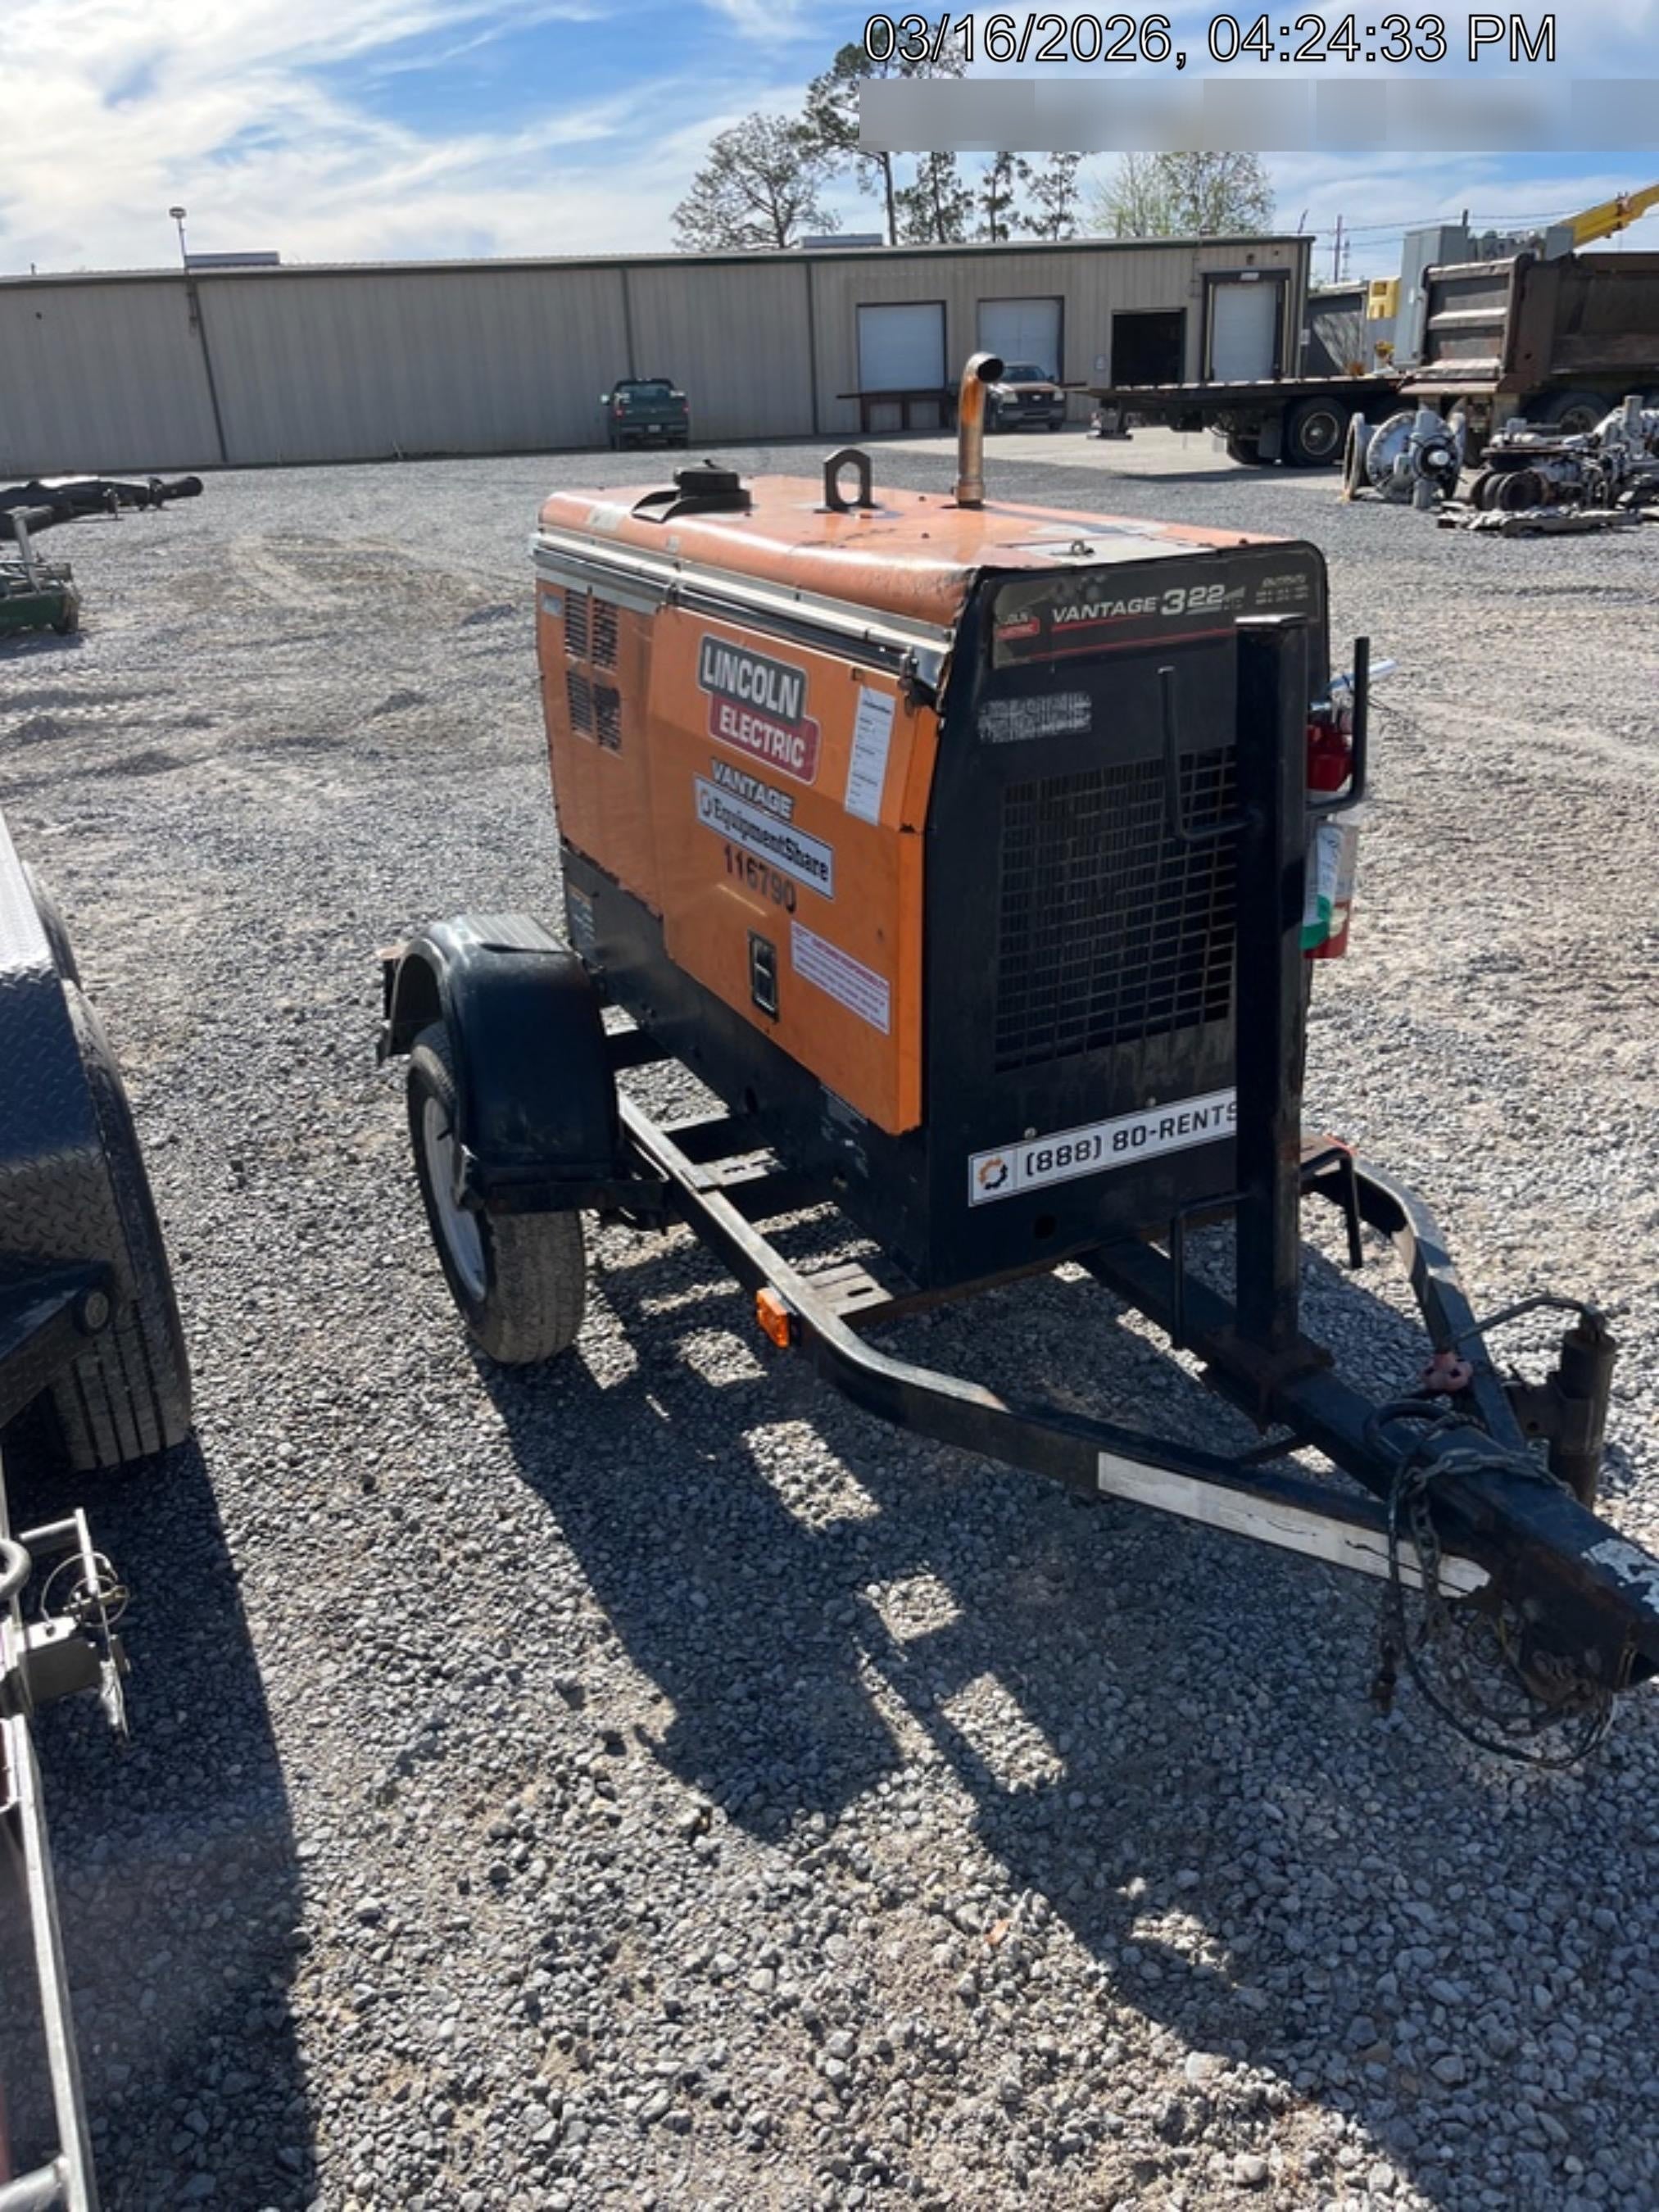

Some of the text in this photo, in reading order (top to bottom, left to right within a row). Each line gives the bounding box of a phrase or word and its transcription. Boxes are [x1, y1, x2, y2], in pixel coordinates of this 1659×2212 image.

[1052, 596, 1158, 623] VANTAGE
[702, 645, 800, 719] LINCOLN
[719, 705, 805, 768] ELECTRIC
[711, 759, 794, 820] VANTAGE
[714, 797, 828, 882] EquipmentShare
[724, 844, 797, 914] 116790
[1027, 1135, 1102, 1176] (888)
